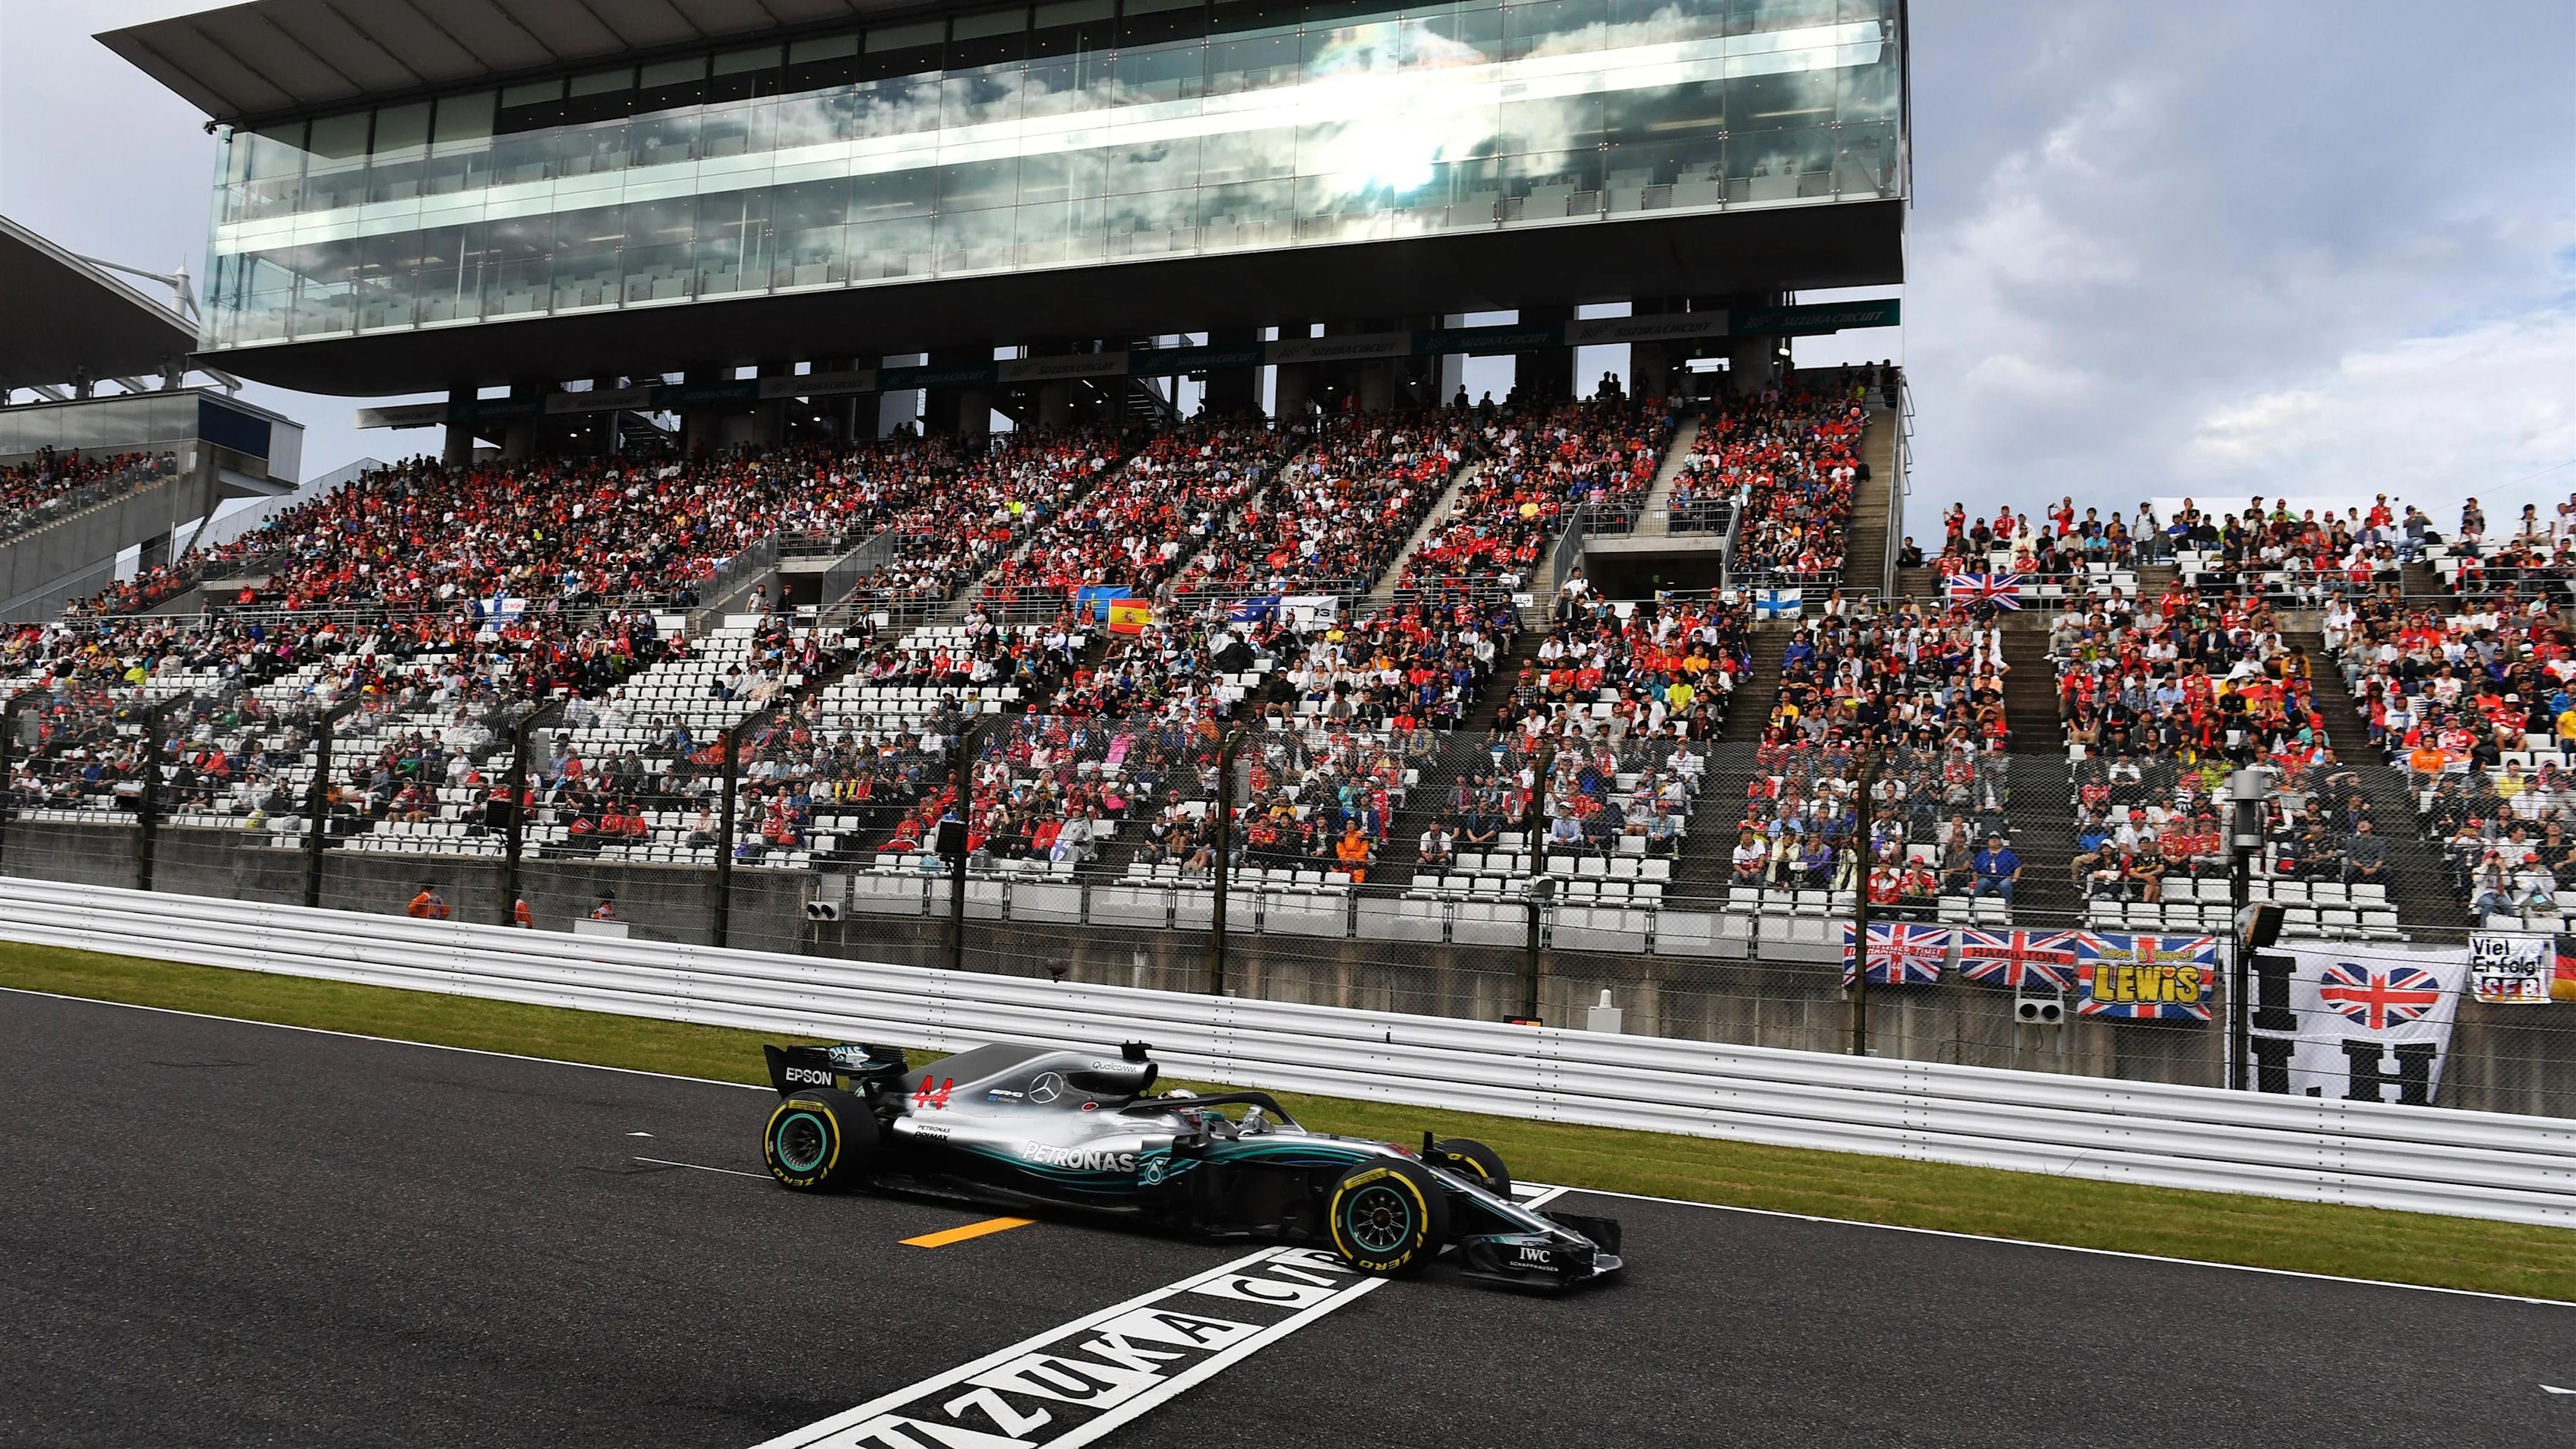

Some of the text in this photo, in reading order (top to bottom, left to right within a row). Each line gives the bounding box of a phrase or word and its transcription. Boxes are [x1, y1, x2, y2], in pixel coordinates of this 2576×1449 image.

[1782, 311, 1885, 327] SUZUKA CIRCUIT
[1616, 321, 1711, 336] SUZUKA CIRCUIT
[1460, 333, 1550, 348] SUZUKA CIRCUIT
[1309, 342, 1397, 357] SUZUKA CIRCUIT
[1176, 352, 1259, 366] SUZUKA CIRCUIT
[1037, 361, 1116, 375] SUZUKA CIRCUIT
[1867, 945, 1910, 956] HAMMER
[1915, 947, 1941, 958] TIME!
[1972, 948, 2059, 961] HAMILTON
[2099, 945, 2132, 961] Love
[2137, 948, 2148, 961] &
[2472, 939, 2510, 955] Viel
[2472, 955, 2542, 976] Erfolg!
[2483, 978, 2540, 999] SEB
[785, 1067, 832, 1086] EPSON
[911, 1075, 953, 1110] 44
[914, 1132, 949, 1142] PRIMAX
[917, 1125, 951, 1134] PETRONAS
[1022, 1141, 1137, 1173] PETRONAS
[773, 1167, 815, 1186] ZERO
[1359, 1249, 1413, 1271] ZERO
[1519, 1246, 1551, 1263] IWC
[1509, 1260, 1559, 1272] SCHAFFHAUSEN
